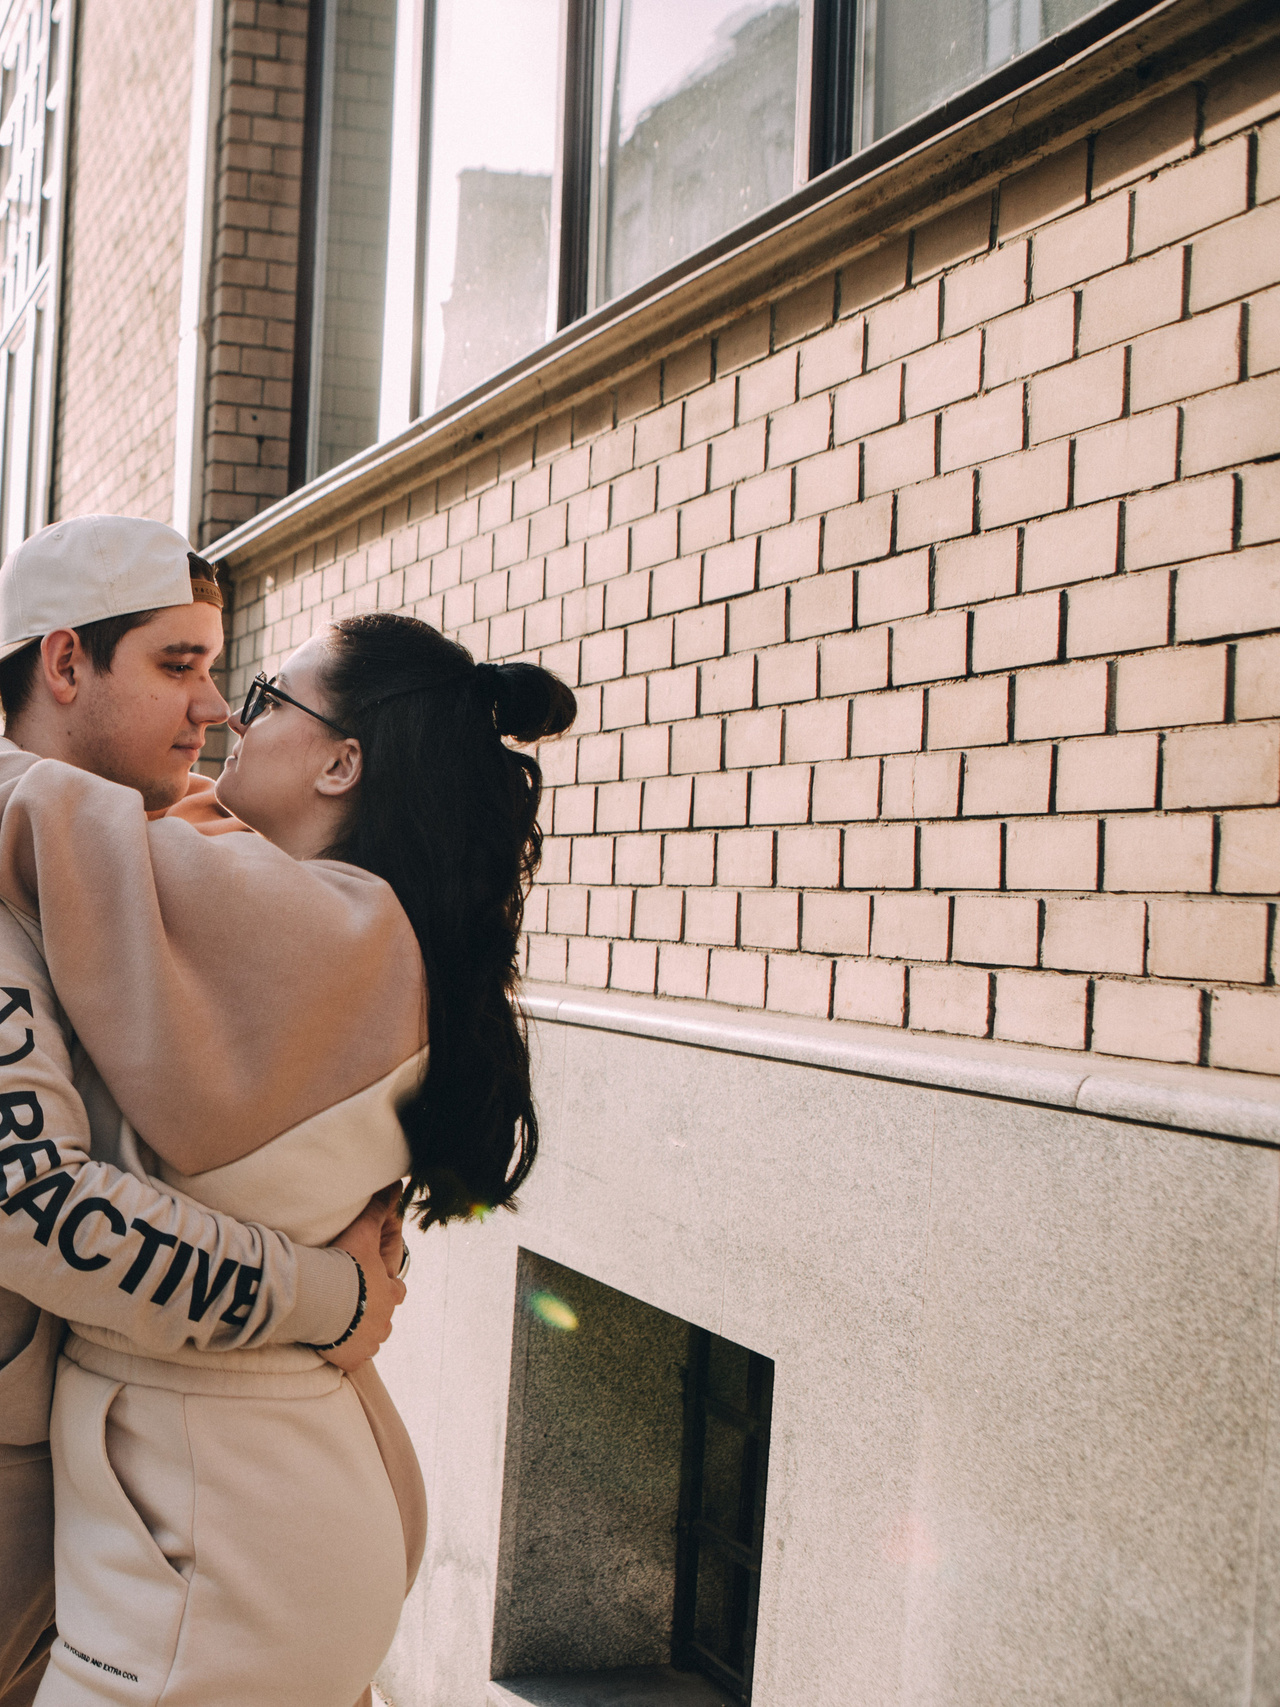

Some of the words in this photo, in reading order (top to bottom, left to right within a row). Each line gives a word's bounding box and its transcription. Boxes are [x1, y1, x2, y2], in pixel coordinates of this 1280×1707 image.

[90, 1658, 103, 1668] AND
[103, 1663, 122, 1676] EXTRA
[122, 1671, 139, 1683] COOL
